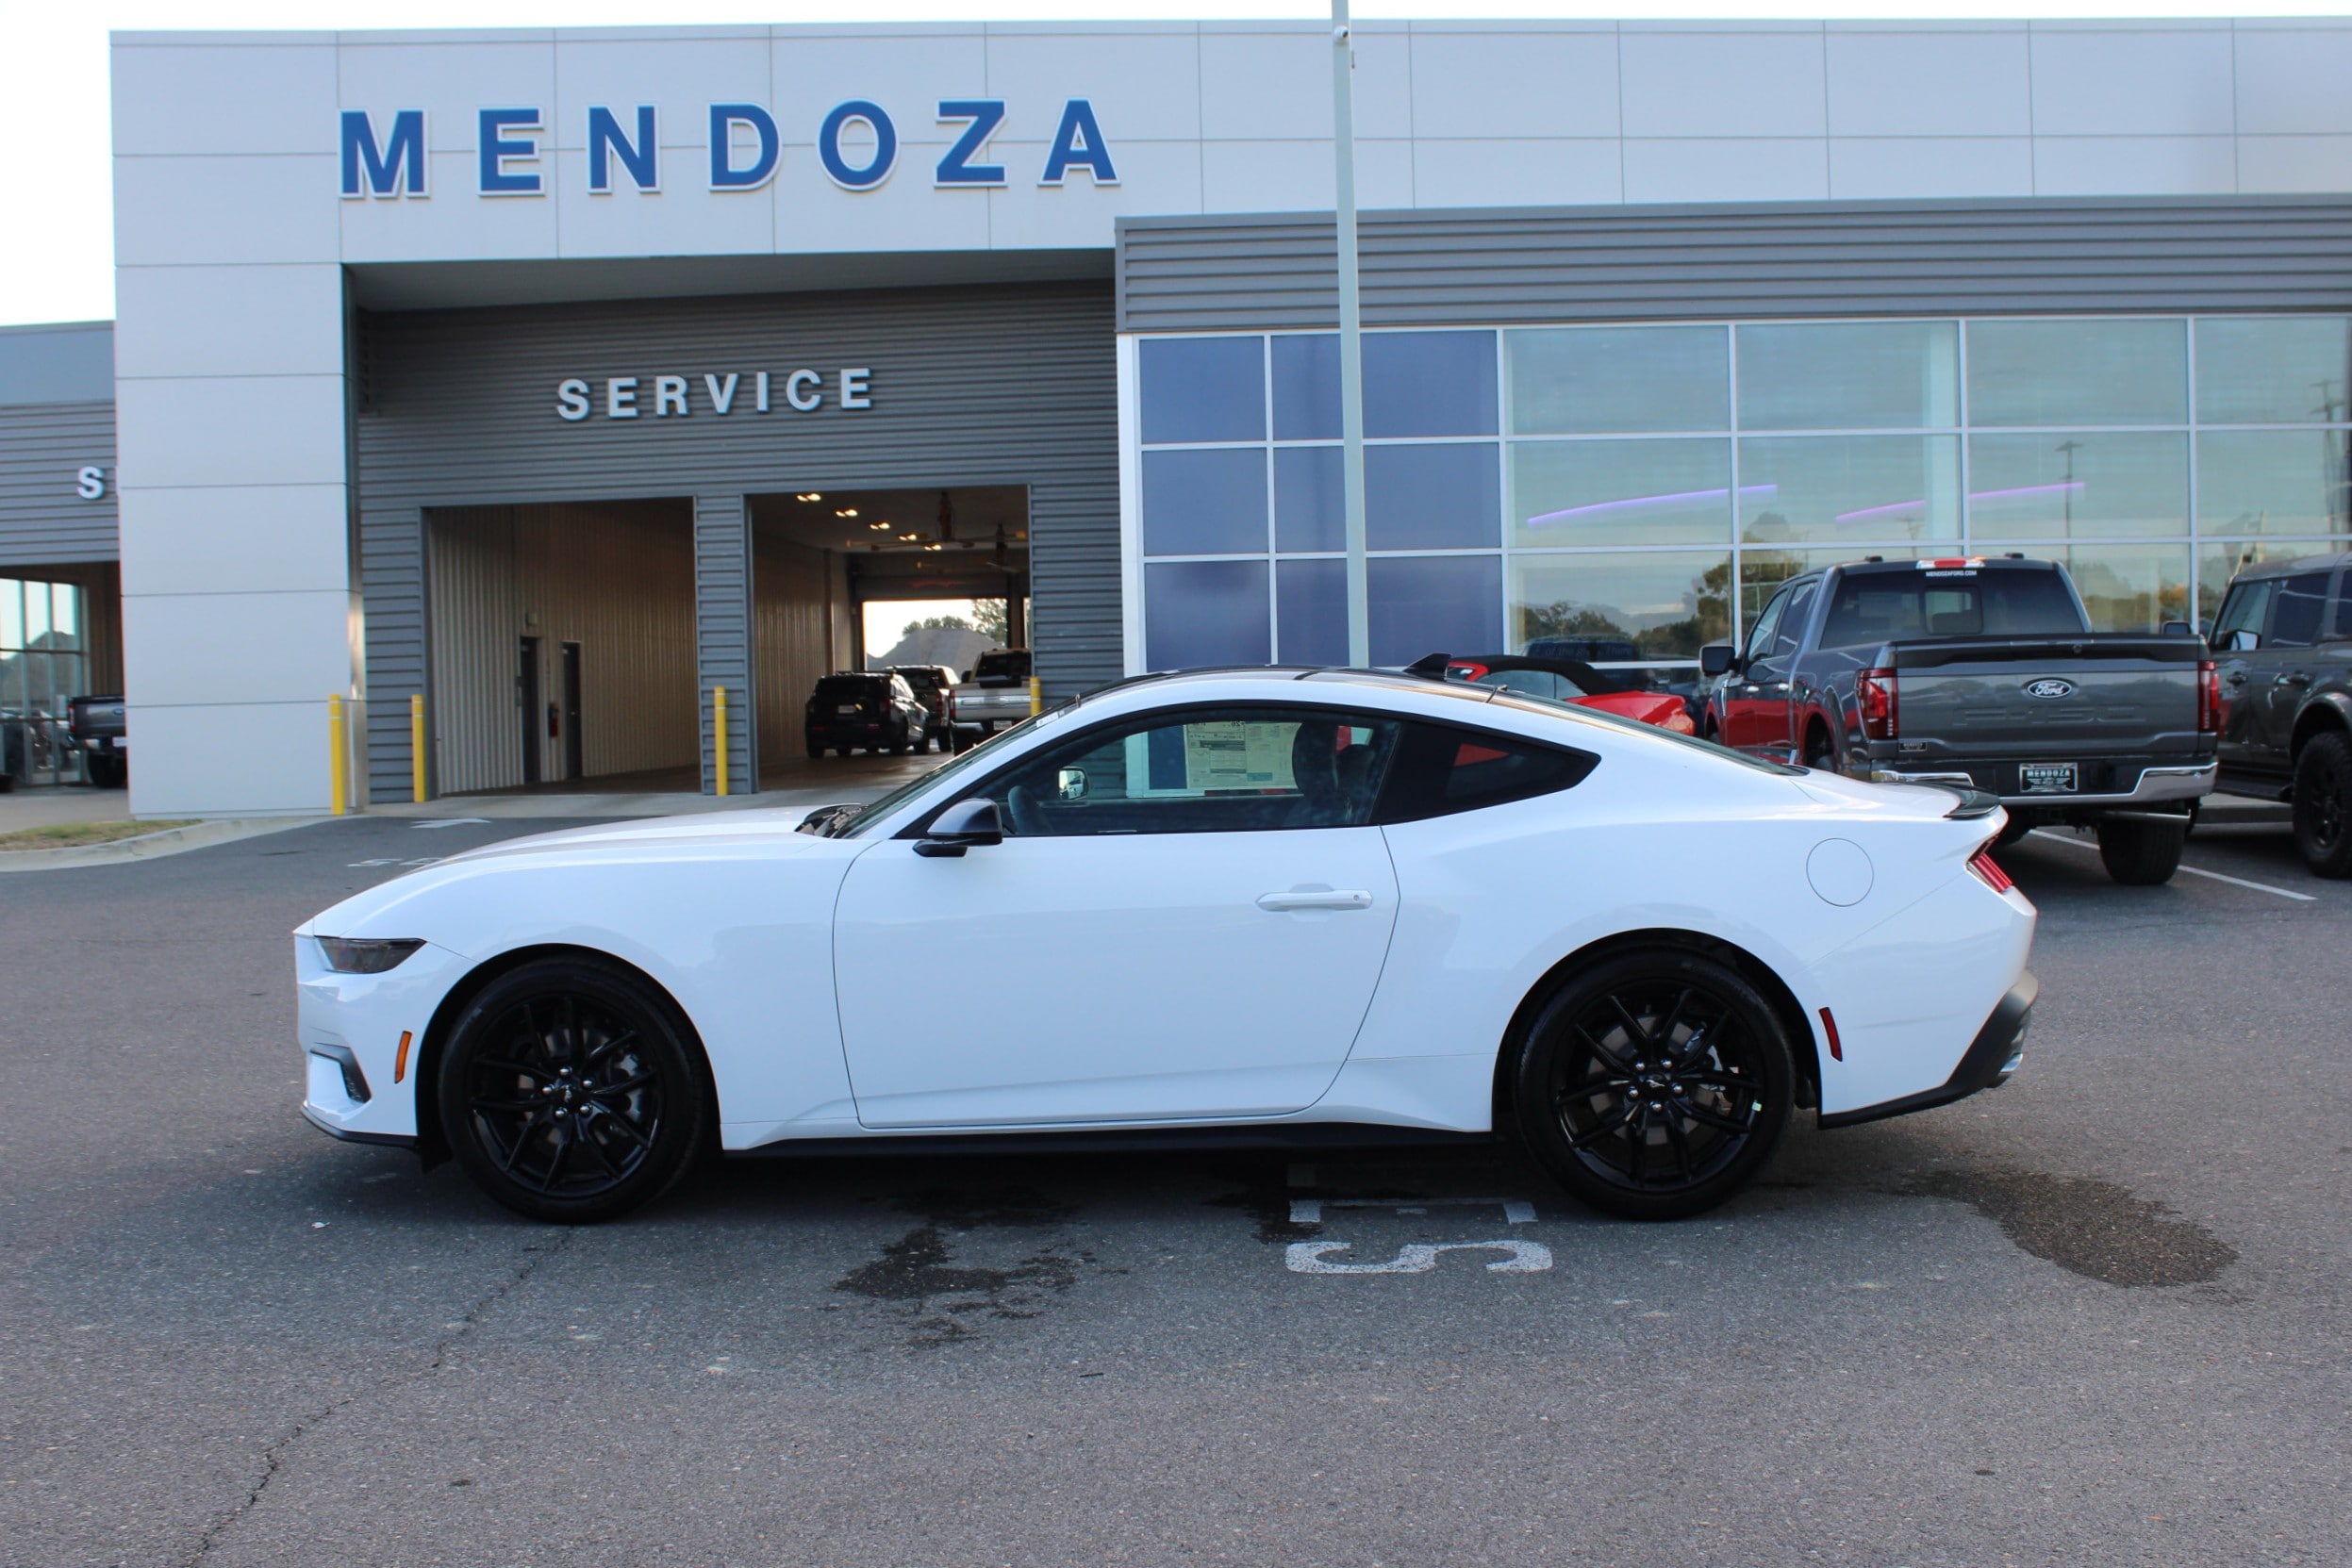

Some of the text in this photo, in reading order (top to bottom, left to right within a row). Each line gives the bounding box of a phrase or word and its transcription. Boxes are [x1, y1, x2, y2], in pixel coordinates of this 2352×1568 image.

[340, 99, 1120, 199] MENDOZA
[556, 367, 872, 421] SERVICE
[76, 465, 118, 501] S
[2033, 681, 2066, 697] Ford
[2026, 768, 2071, 778] MENDOZA
